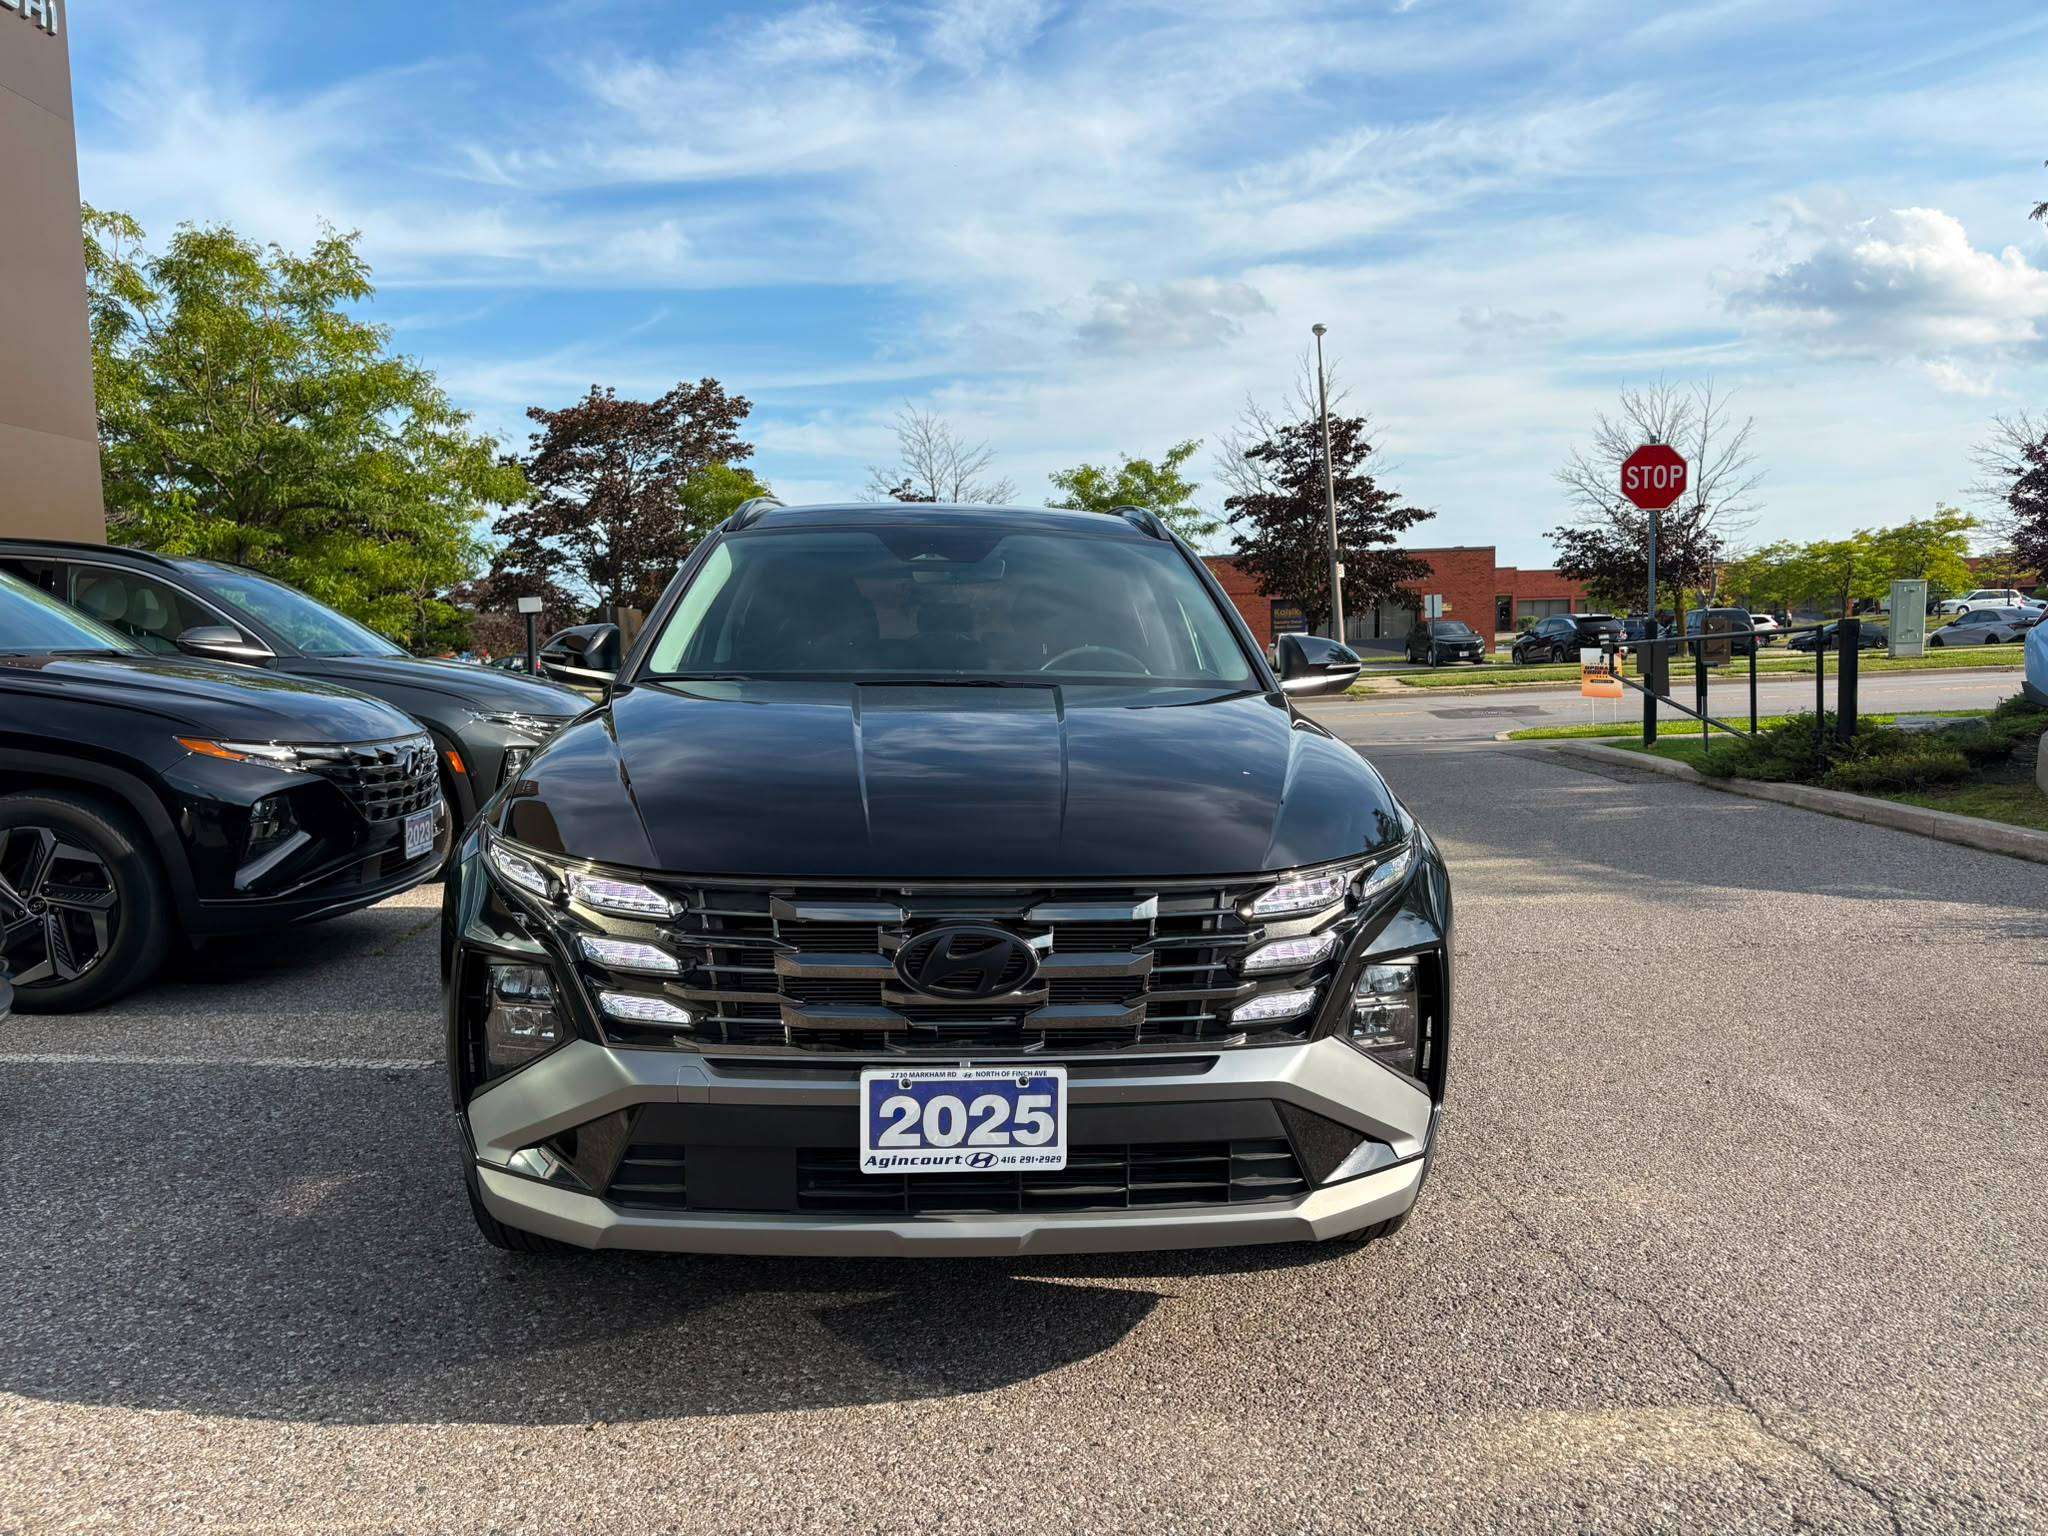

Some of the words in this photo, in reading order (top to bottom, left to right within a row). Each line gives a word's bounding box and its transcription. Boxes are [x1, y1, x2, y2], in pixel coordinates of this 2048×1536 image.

[1626, 464, 1684, 490] STOP
[407, 820, 431, 848] 2023
[878, 1094, 1056, 1148] 2025
[864, 1154, 964, 1169] Agincourt
[1000, 1156, 1017, 1164] 416
